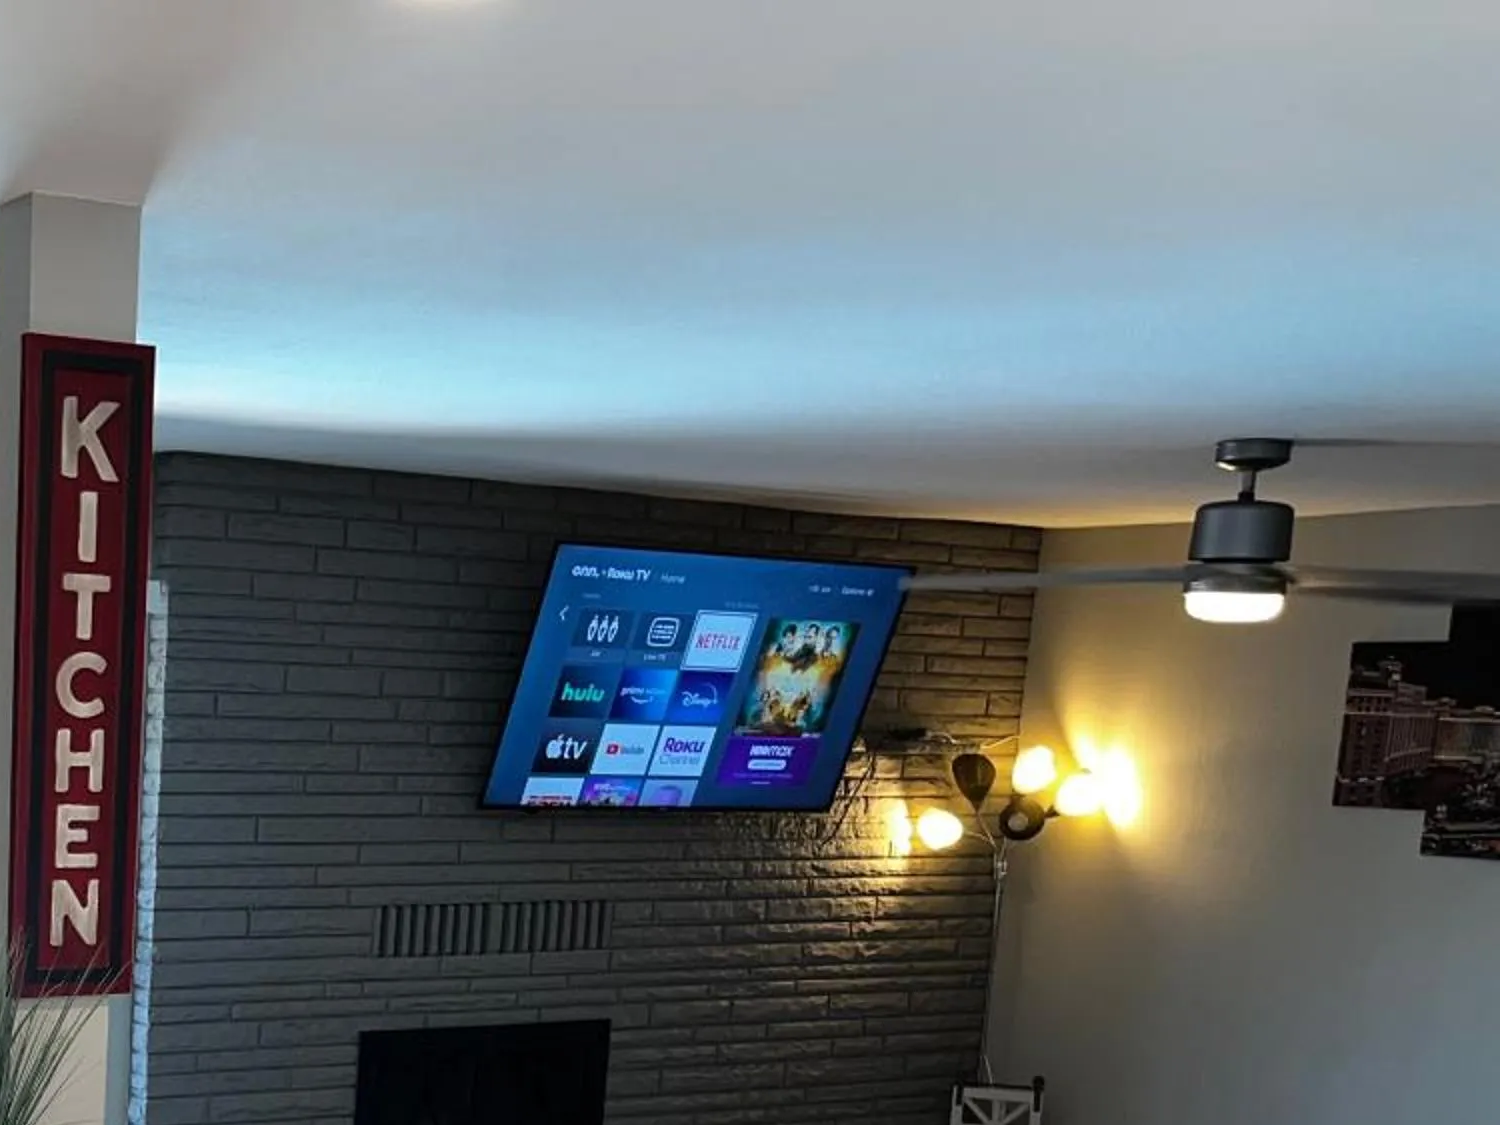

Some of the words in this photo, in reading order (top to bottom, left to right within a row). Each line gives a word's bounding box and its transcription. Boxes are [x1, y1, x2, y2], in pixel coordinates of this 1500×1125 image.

[635, 569, 651, 581] TV
[695, 633, 741, 651] NETFLIX
[48, 395, 120, 947] KITCHEN
[561, 682, 605, 701] hulu
[663, 737, 705, 753] Roku
